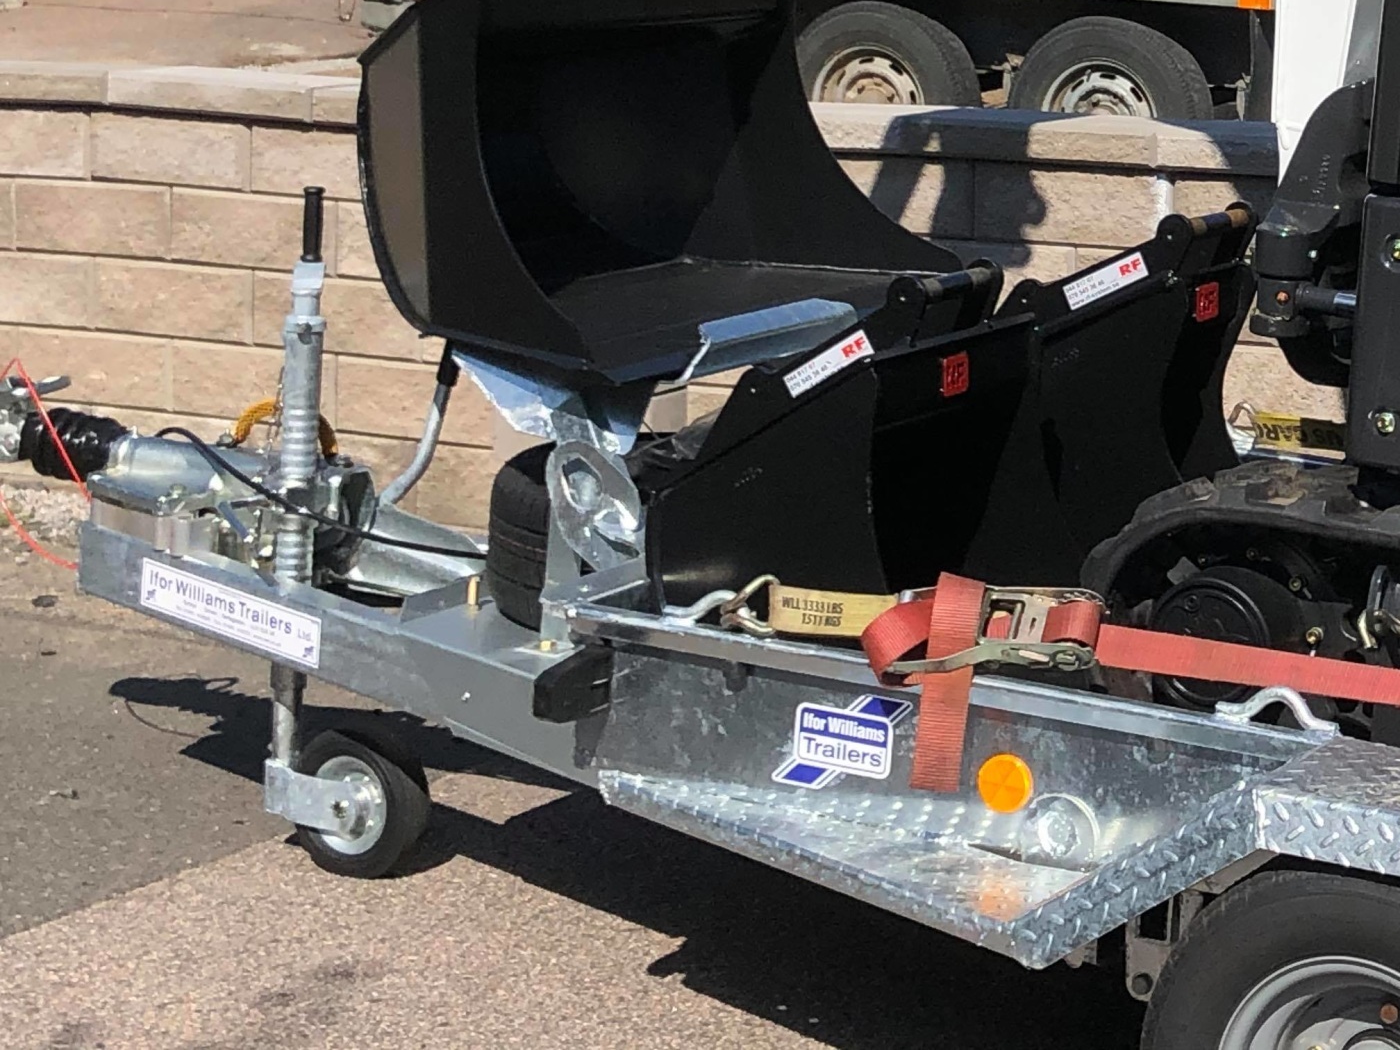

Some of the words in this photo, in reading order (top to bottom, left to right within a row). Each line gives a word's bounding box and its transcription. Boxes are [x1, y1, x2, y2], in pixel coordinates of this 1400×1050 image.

[1119, 258, 1142, 276] RF
[841, 336, 866, 358] RF
[150, 570, 173, 591] Ifor
[175, 579, 236, 614] Williams
[239, 601, 292, 635] Trailers
[782, 596, 801, 610] WLL
[802, 599, 825, 613] 3333
[803, 712, 827, 731] Ifor
[827, 716, 886, 743] Williams
[803, 736, 882, 767] Trailers
